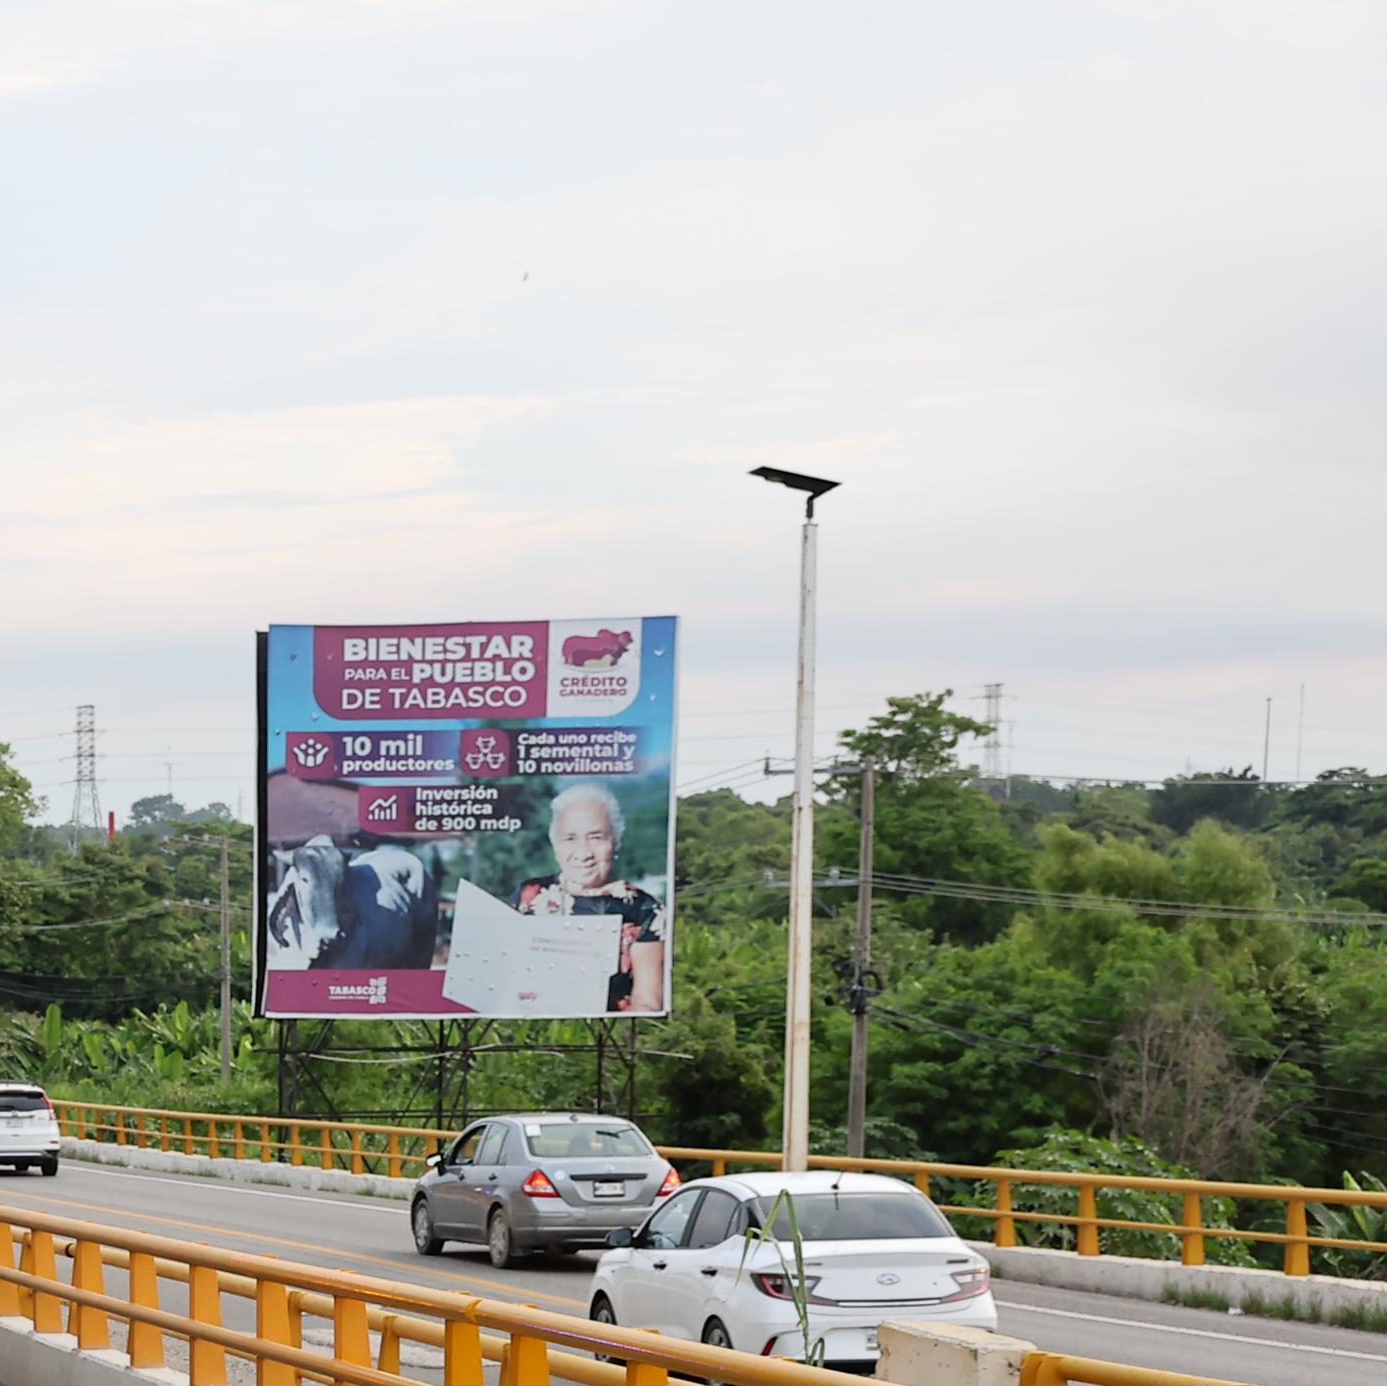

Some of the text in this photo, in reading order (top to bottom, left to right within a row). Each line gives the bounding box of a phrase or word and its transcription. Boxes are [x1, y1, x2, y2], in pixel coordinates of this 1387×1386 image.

[343, 635, 534, 661] BIENESTAR
[344, 660, 536, 684] PARA EL PUEBLO
[560, 675, 627, 688] CRÉDITO
[342, 686, 527, 710] DE TABASCO
[342, 733, 423, 756] 10 mil
[517, 731, 637, 745] Cada uno recibe
[517, 744, 636, 760] 1 semental y
[342, 758, 455, 775] productores
[517, 758, 634, 773] 10 novillonas
[416, 784, 499, 801] Inversión
[415, 800, 493, 816] histórica
[414, 815, 522, 833] de 900 mdp
[329, 986, 376, 995] TABASCO
